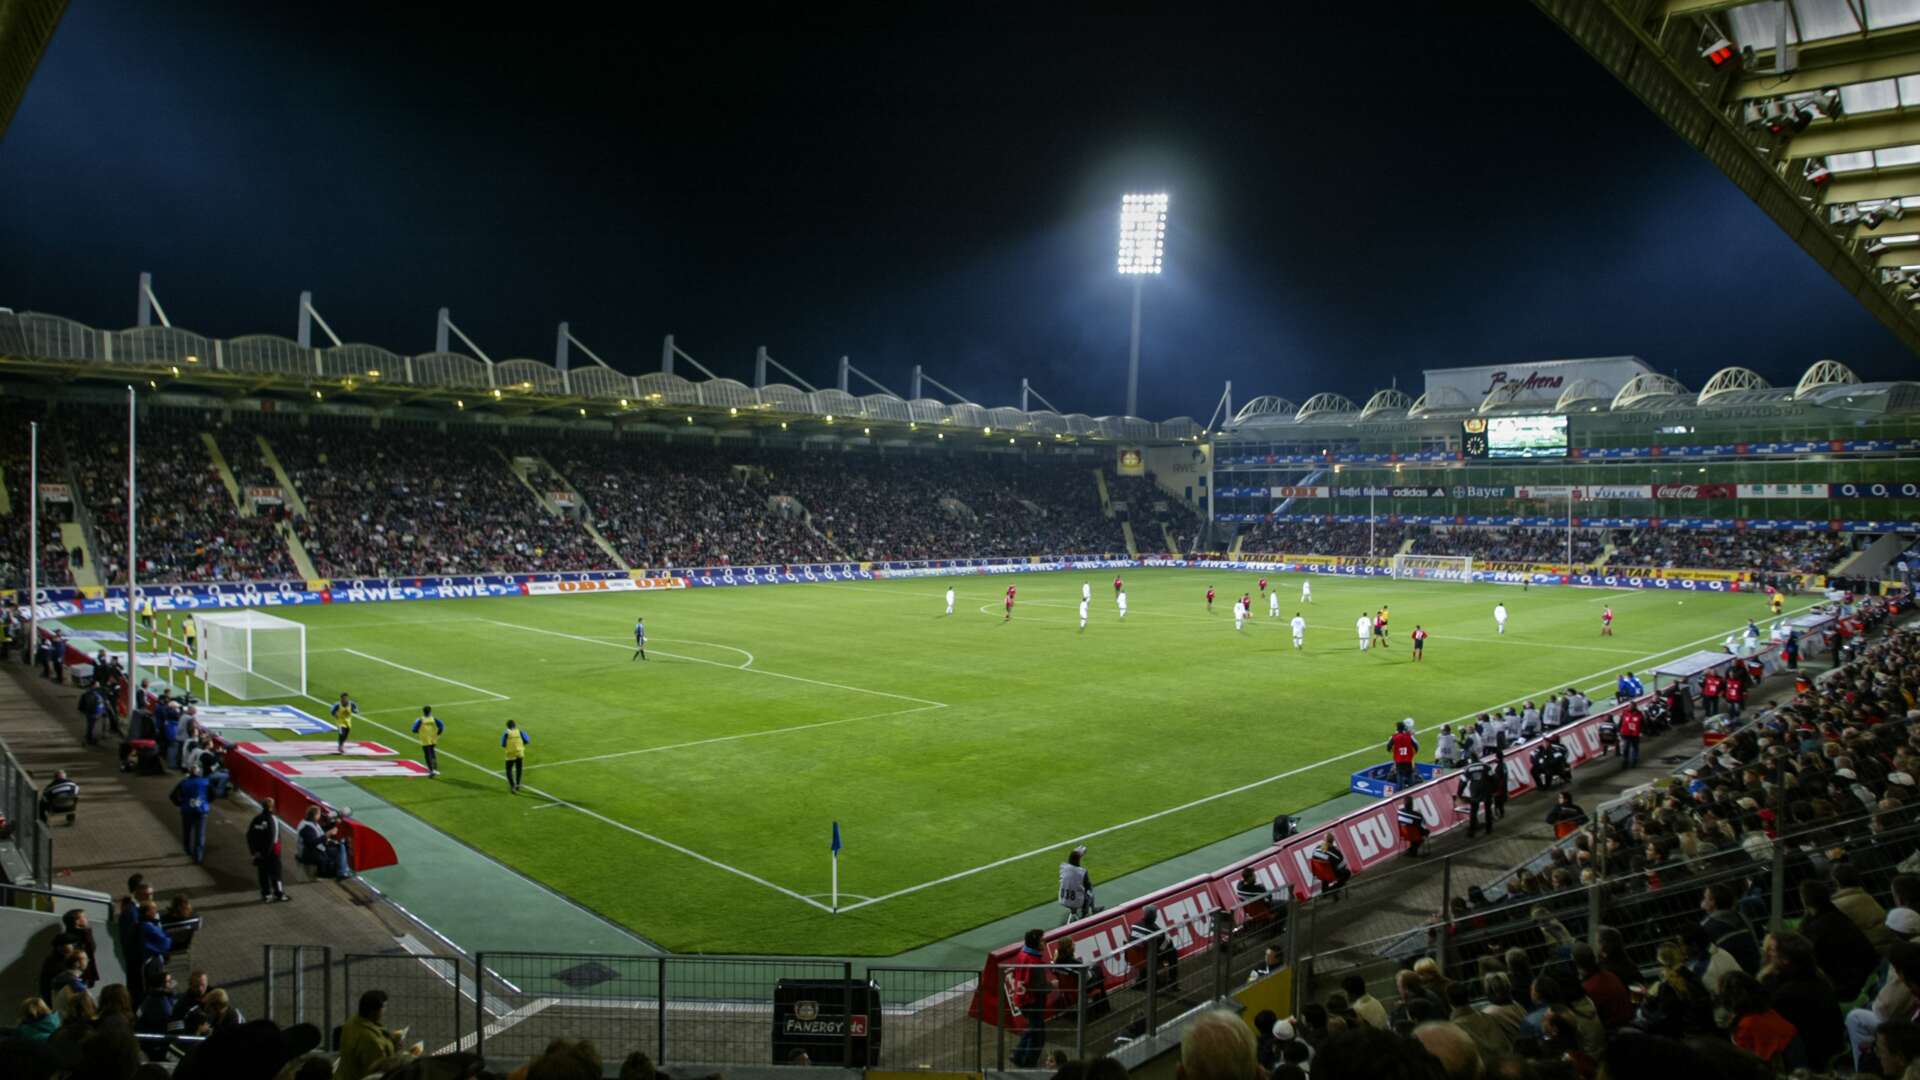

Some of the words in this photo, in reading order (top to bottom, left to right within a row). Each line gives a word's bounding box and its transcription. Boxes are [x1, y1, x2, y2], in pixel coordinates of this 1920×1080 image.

[1482, 371, 1564, 400] BayArena
[1172, 463, 1198, 473] RWE
[1393, 487, 1428, 497] adidas
[1467, 486, 1506, 498] Bayer
[1144, 559, 1176, 567] RWE
[1201, 560, 1229, 568] RWE
[1246, 562, 1276, 571] RWE
[559, 579, 608, 592] OBI
[218, 592, 283, 607] RWE
[348, 588, 405, 602] RWE
[438, 584, 490, 598] RWE
[1349, 813, 1394, 861] LTU
[1073, 924, 1132, 977] TU
[786, 1019, 845, 1033] FANERGY
